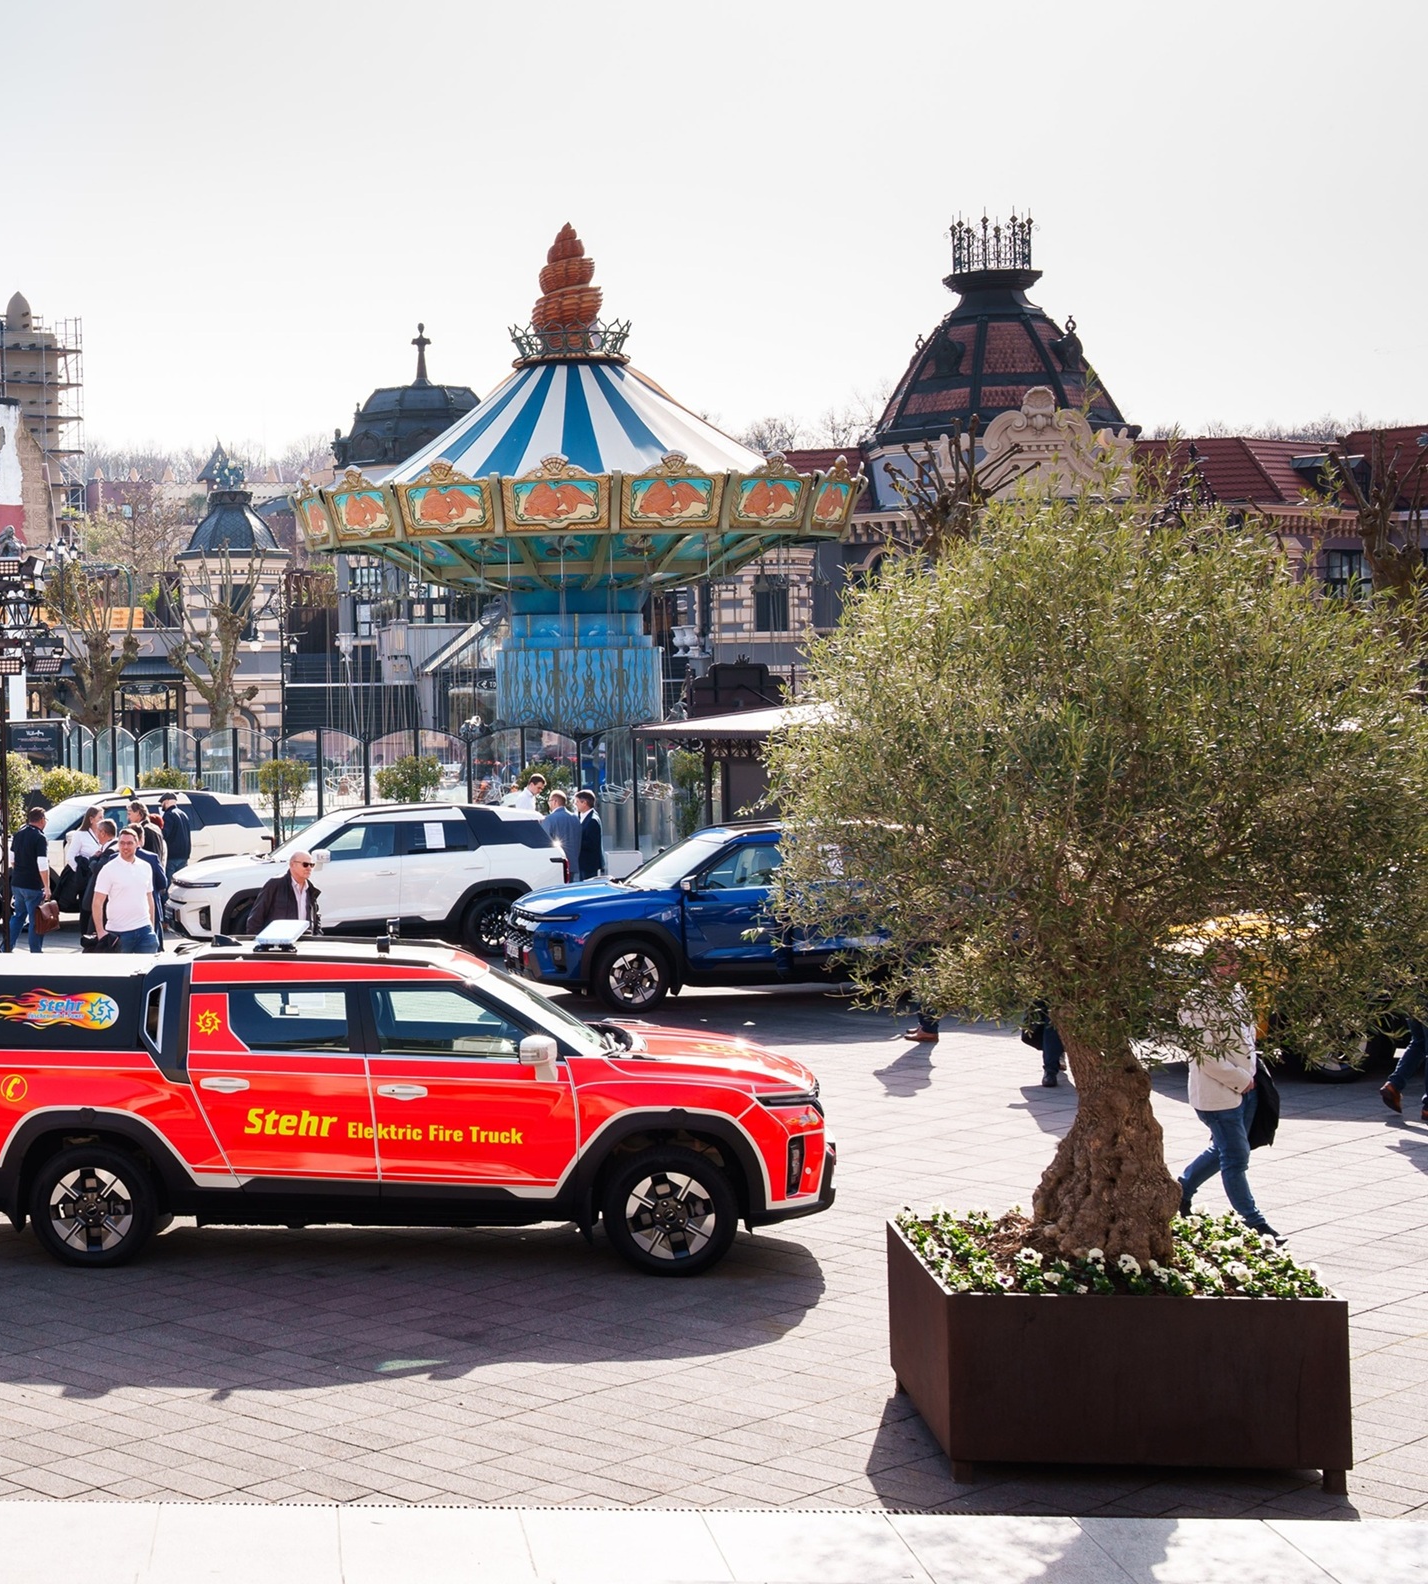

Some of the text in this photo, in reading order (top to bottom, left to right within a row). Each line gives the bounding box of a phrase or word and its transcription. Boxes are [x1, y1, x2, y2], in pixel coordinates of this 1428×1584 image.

[37, 998, 84, 1012] Stehr
[244, 1107, 523, 1144] Stehr Elektric Fire Truck
